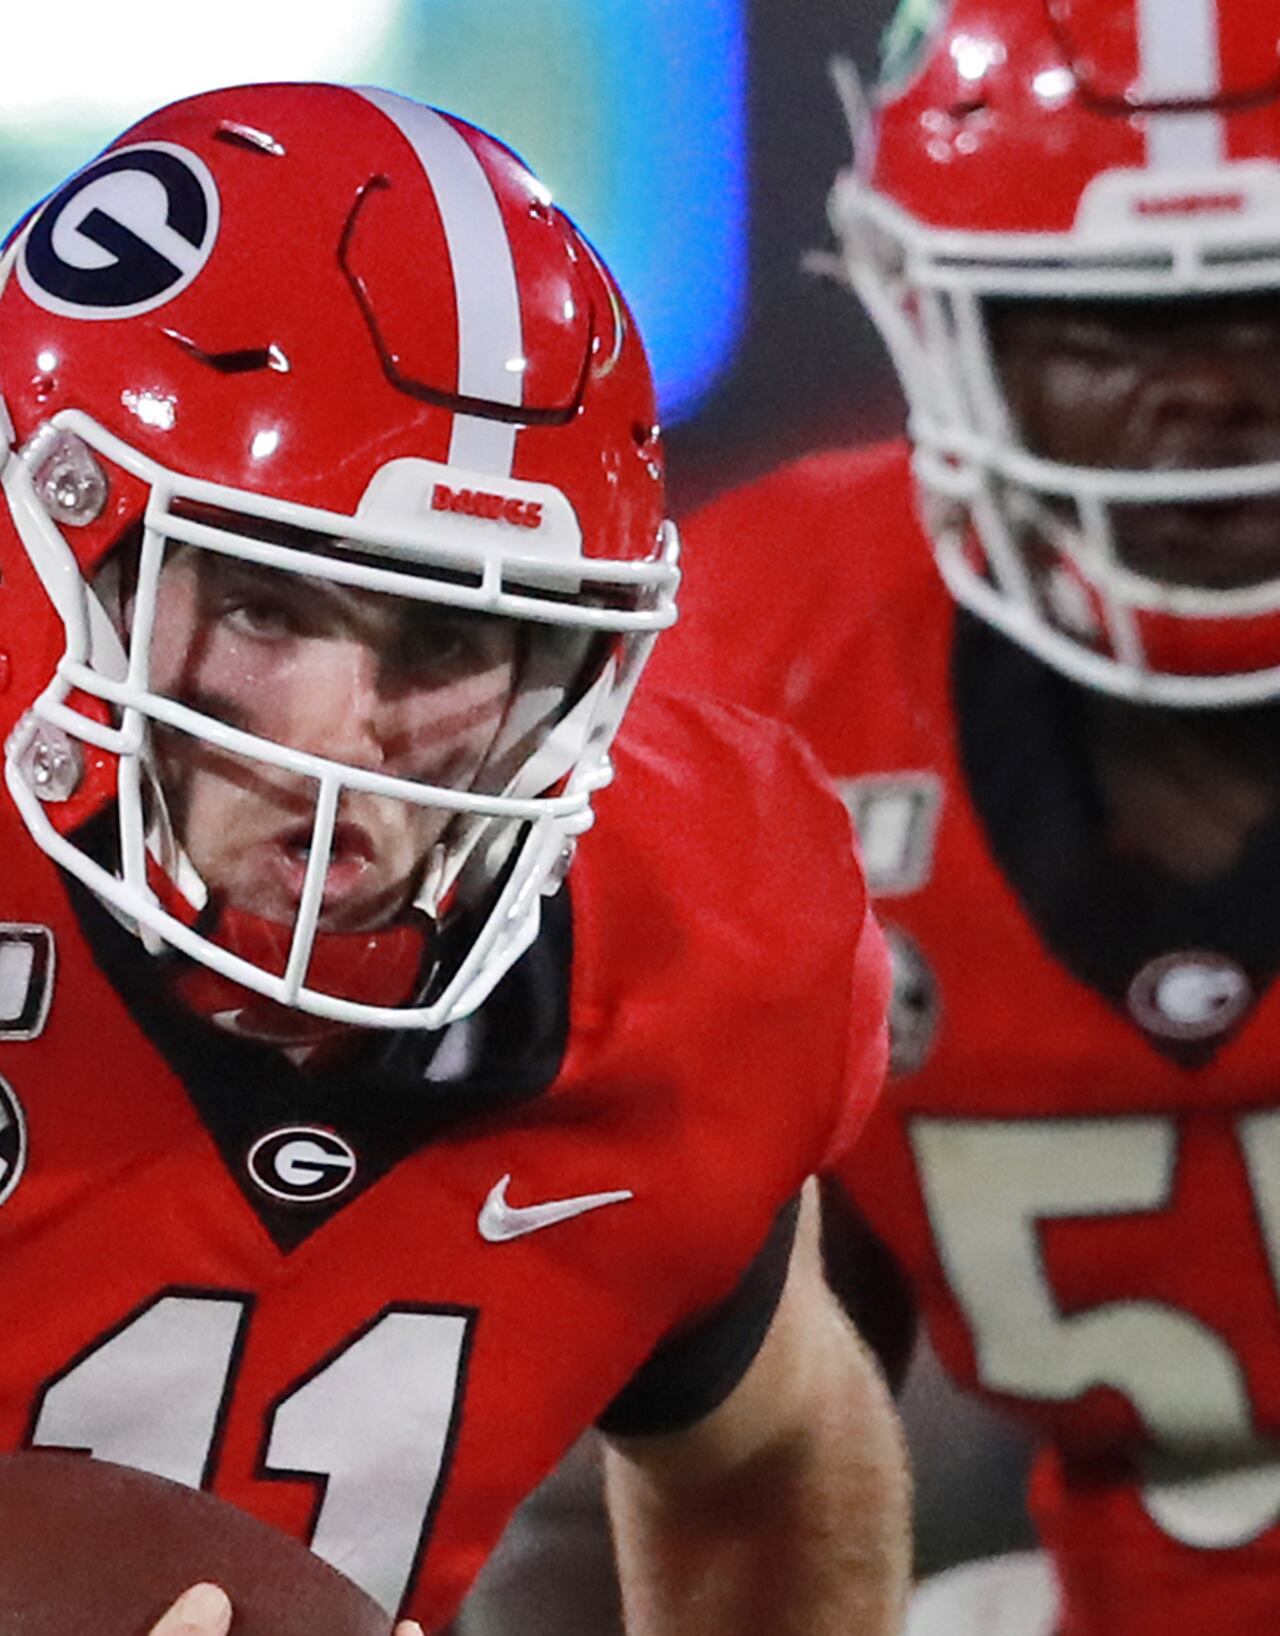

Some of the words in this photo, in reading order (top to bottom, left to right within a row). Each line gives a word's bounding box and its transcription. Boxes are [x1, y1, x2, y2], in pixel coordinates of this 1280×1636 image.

[20, 146, 210, 311] G
[251, 1130, 355, 1199] G
[22, 1283, 479, 1628] 11
[906, 1115, 1280, 1550] 5
